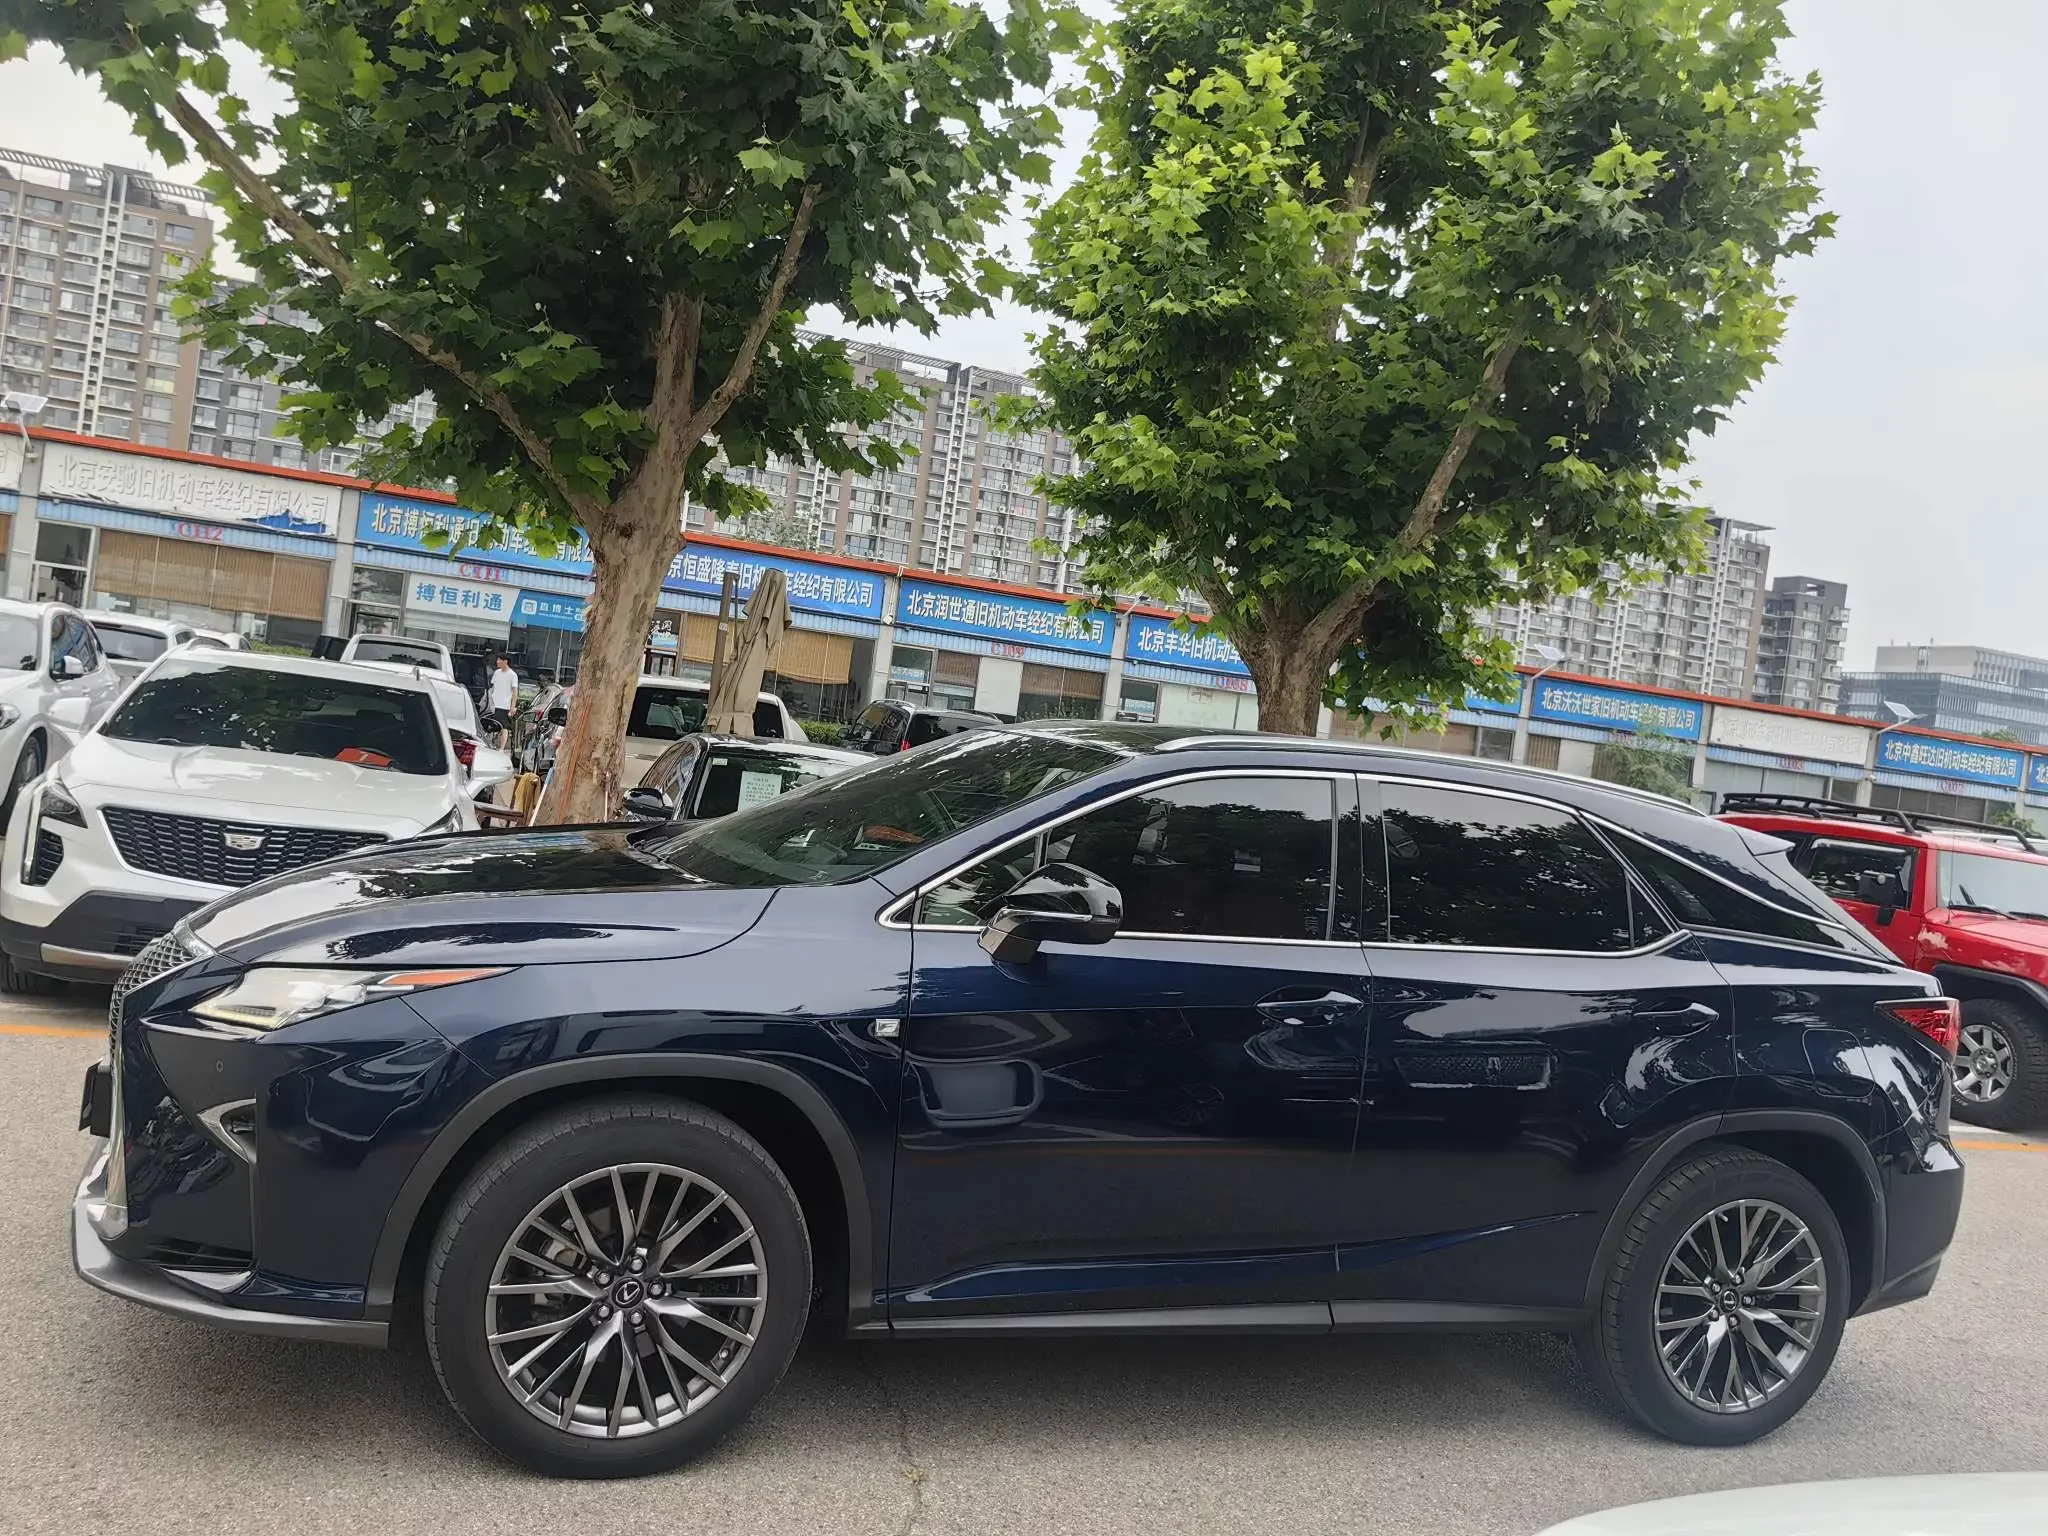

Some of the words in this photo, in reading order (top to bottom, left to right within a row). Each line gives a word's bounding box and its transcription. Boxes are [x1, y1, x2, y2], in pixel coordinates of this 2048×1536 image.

[176, 522, 224, 542] C112
[907, 589, 1106, 645] 北京润世通旧机动车经纪有限公司
